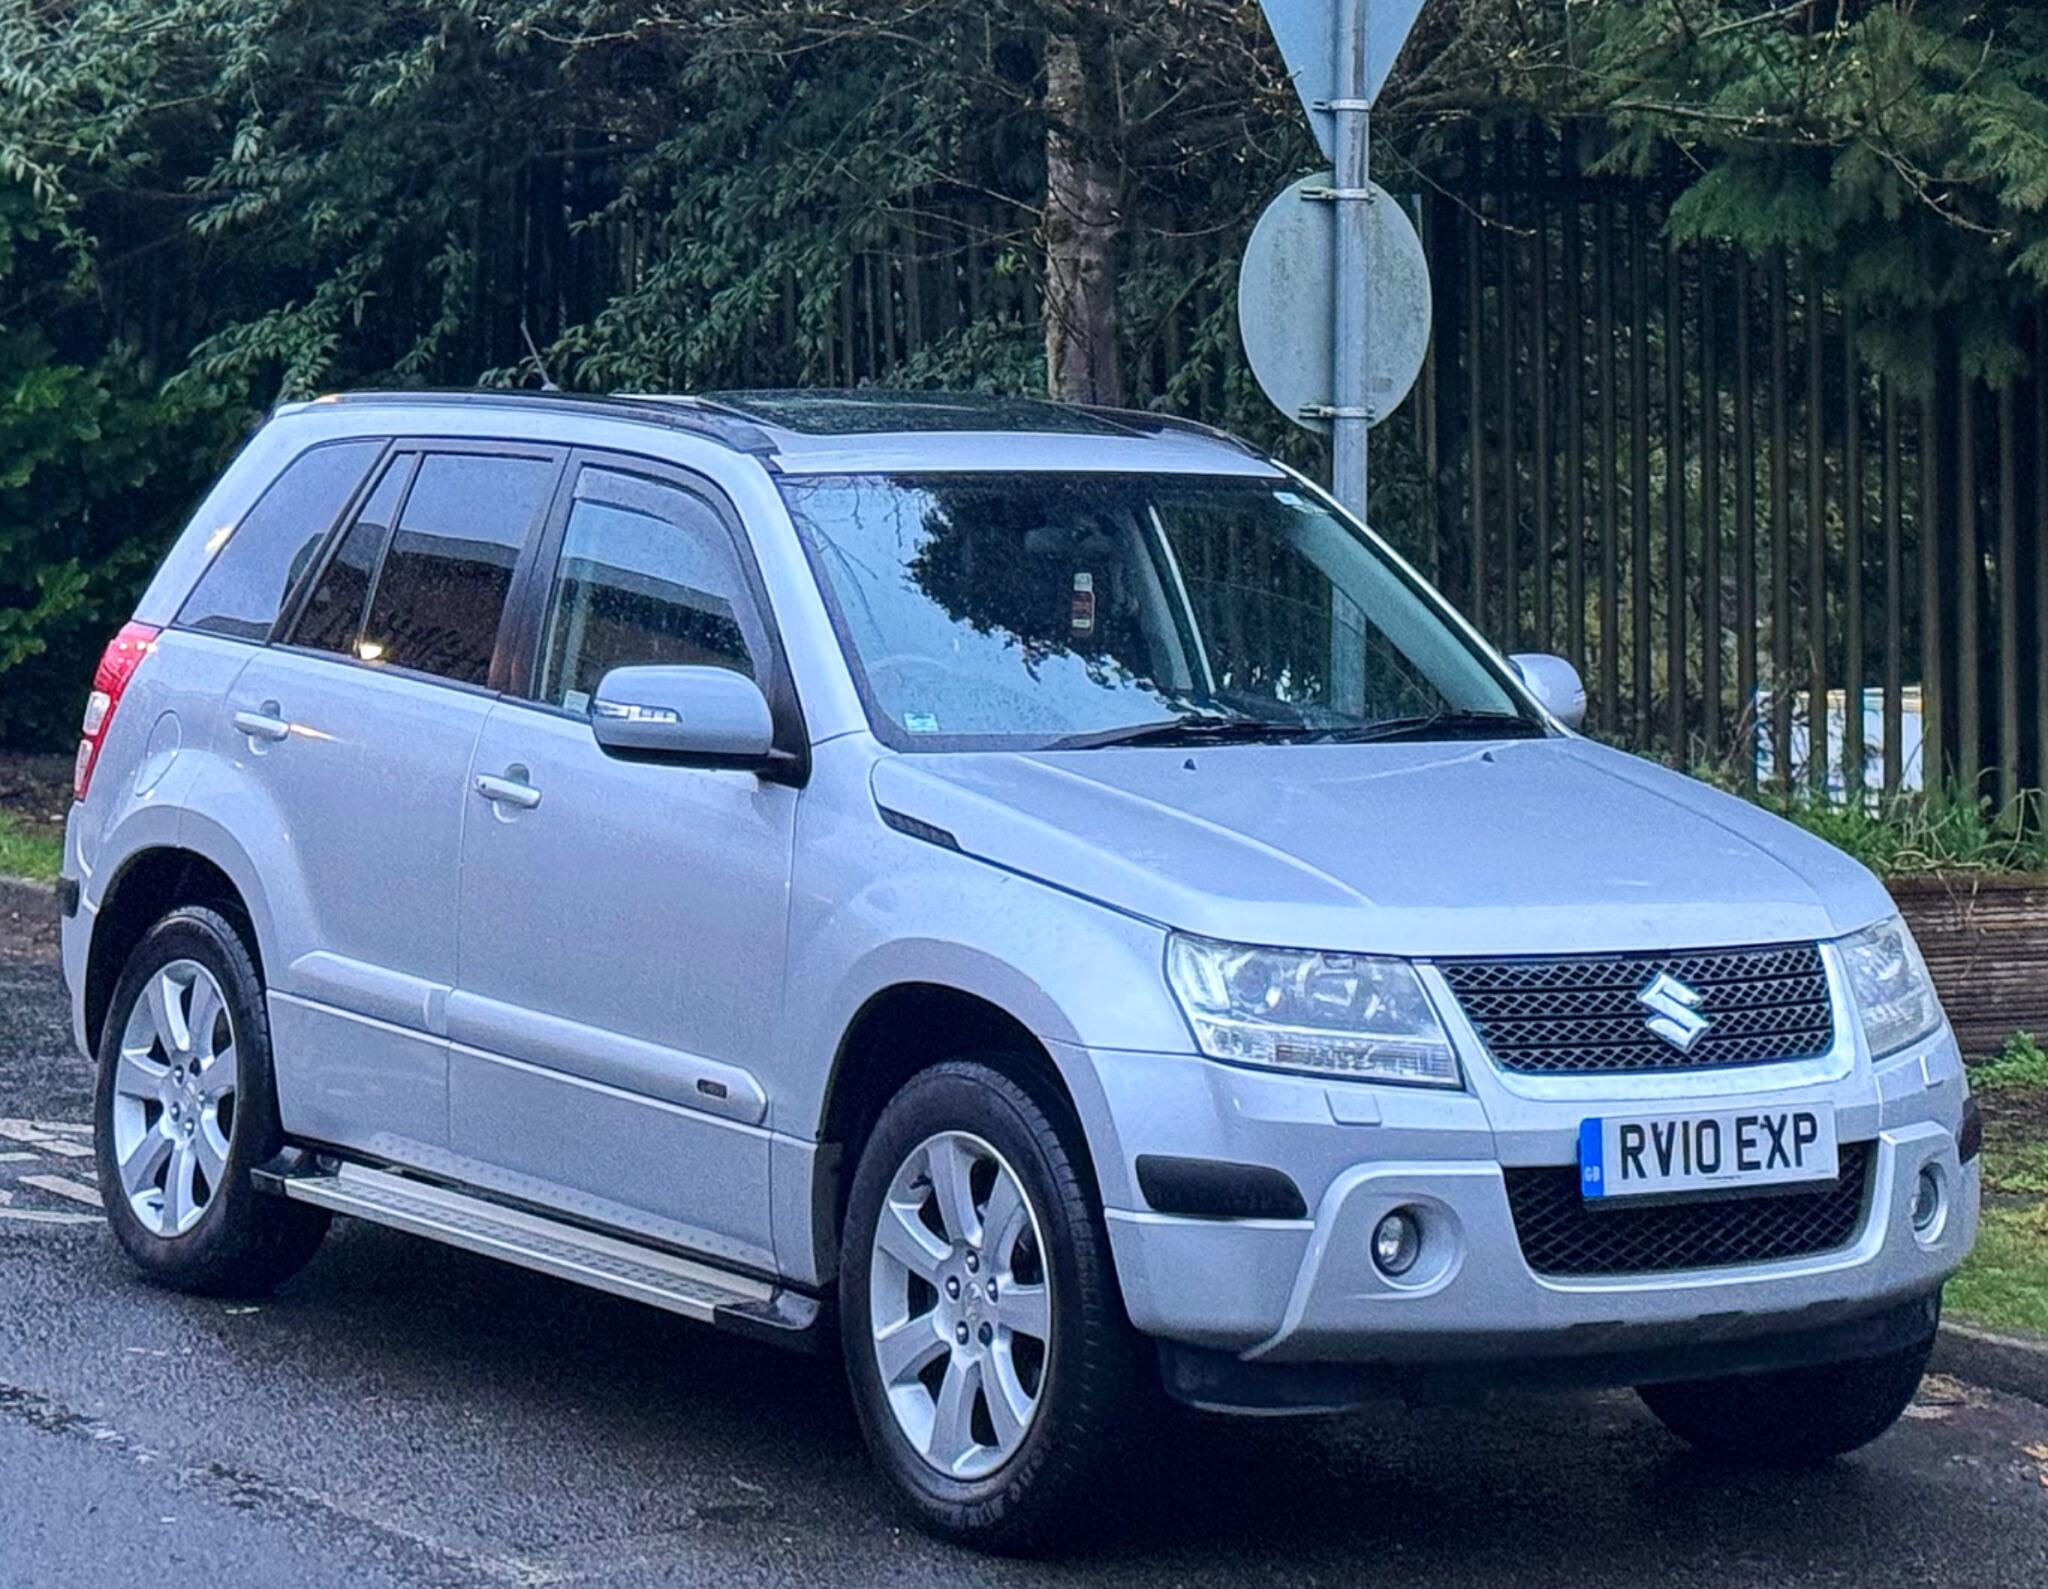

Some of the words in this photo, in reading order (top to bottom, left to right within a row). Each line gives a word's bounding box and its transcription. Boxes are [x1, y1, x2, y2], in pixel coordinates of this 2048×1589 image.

[1619, 1118, 1722, 1180] RV10
[1735, 1112, 1818, 1172] EXP
[1584, 1165, 1600, 1183] GB
